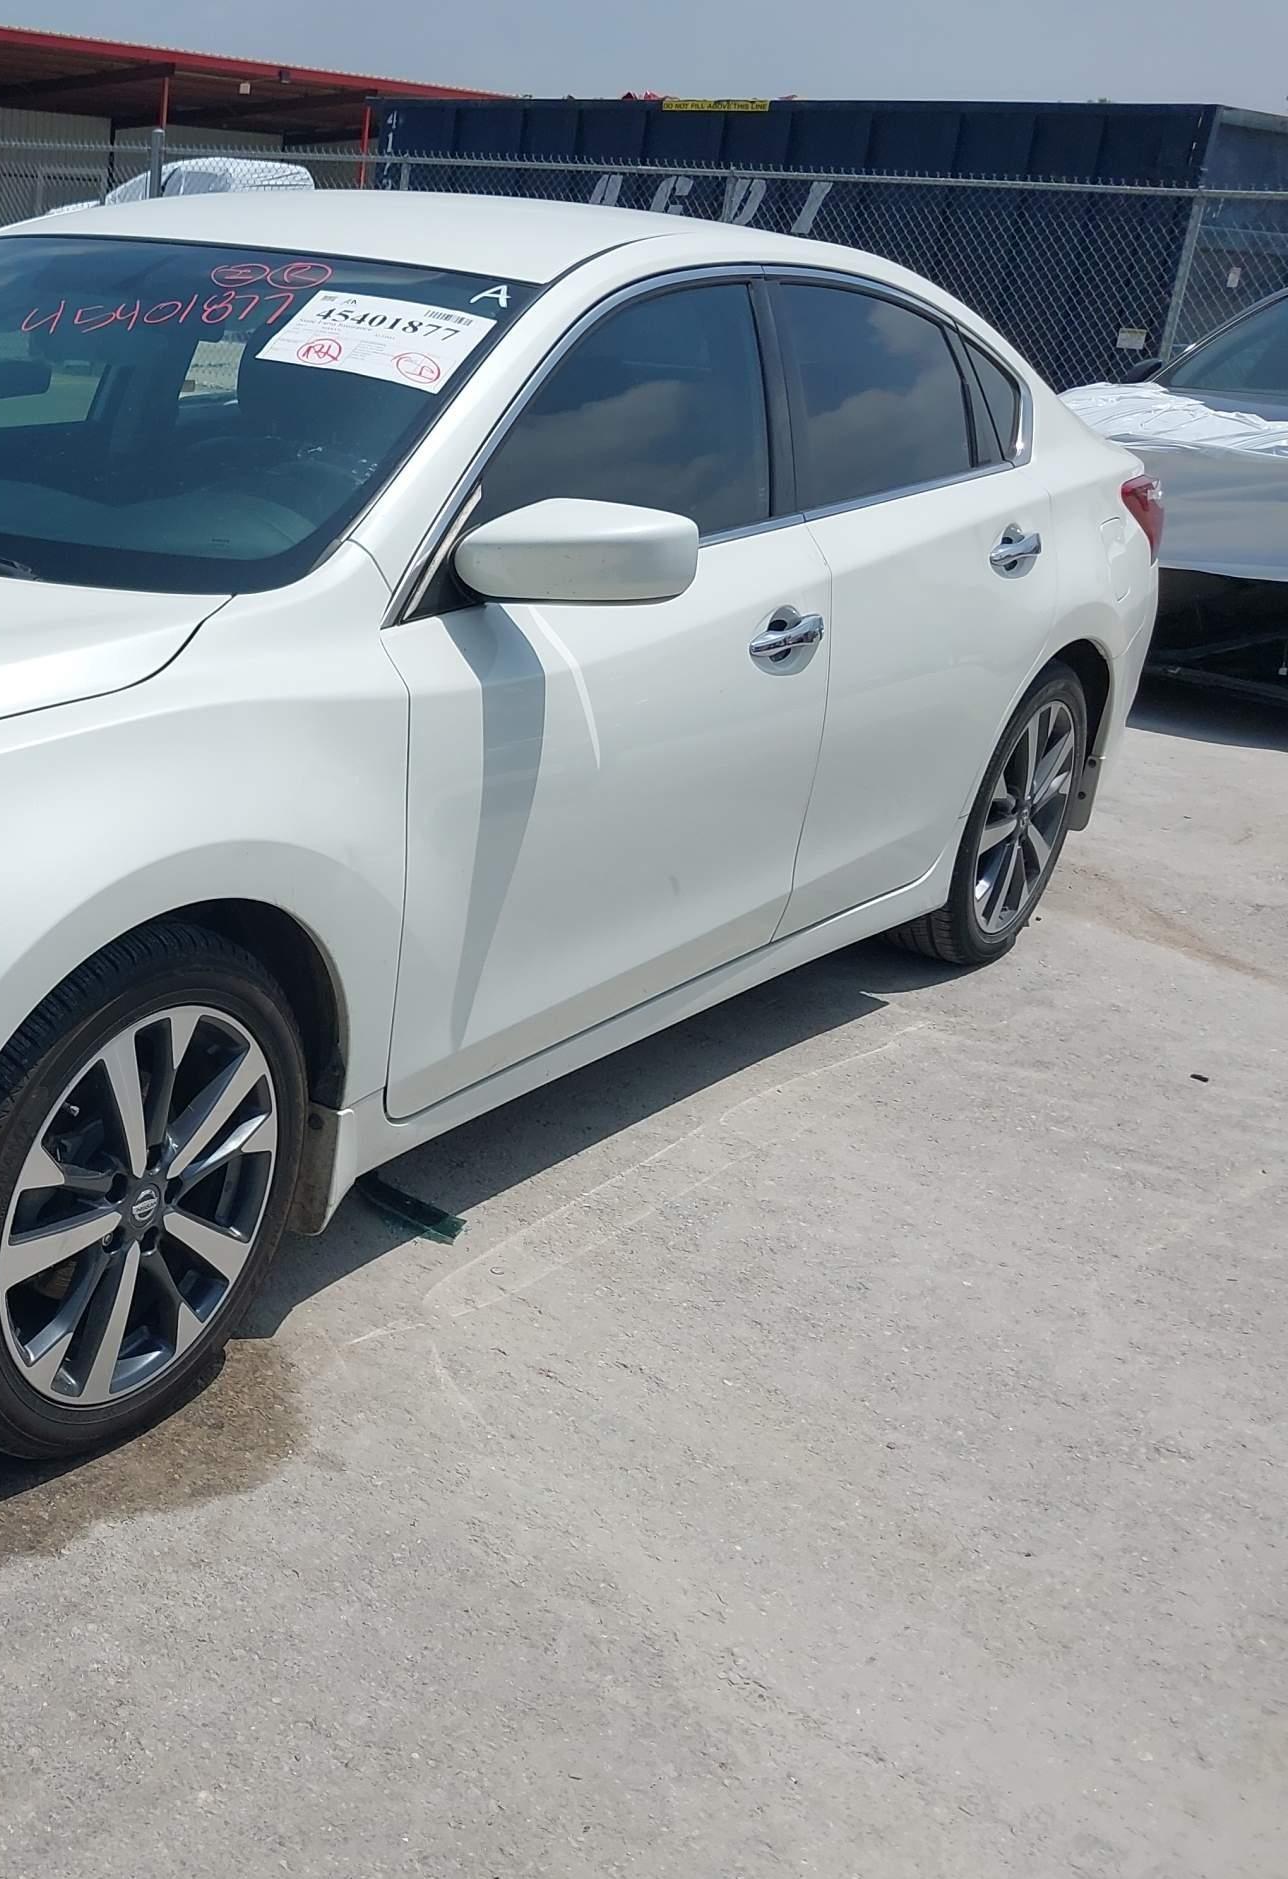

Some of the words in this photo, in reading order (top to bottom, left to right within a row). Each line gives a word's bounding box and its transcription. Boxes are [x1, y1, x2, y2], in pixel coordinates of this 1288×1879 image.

[21, 290, 295, 335] 45401877
[469, 284, 512, 309] A
[316, 307, 462, 341] 45401877
